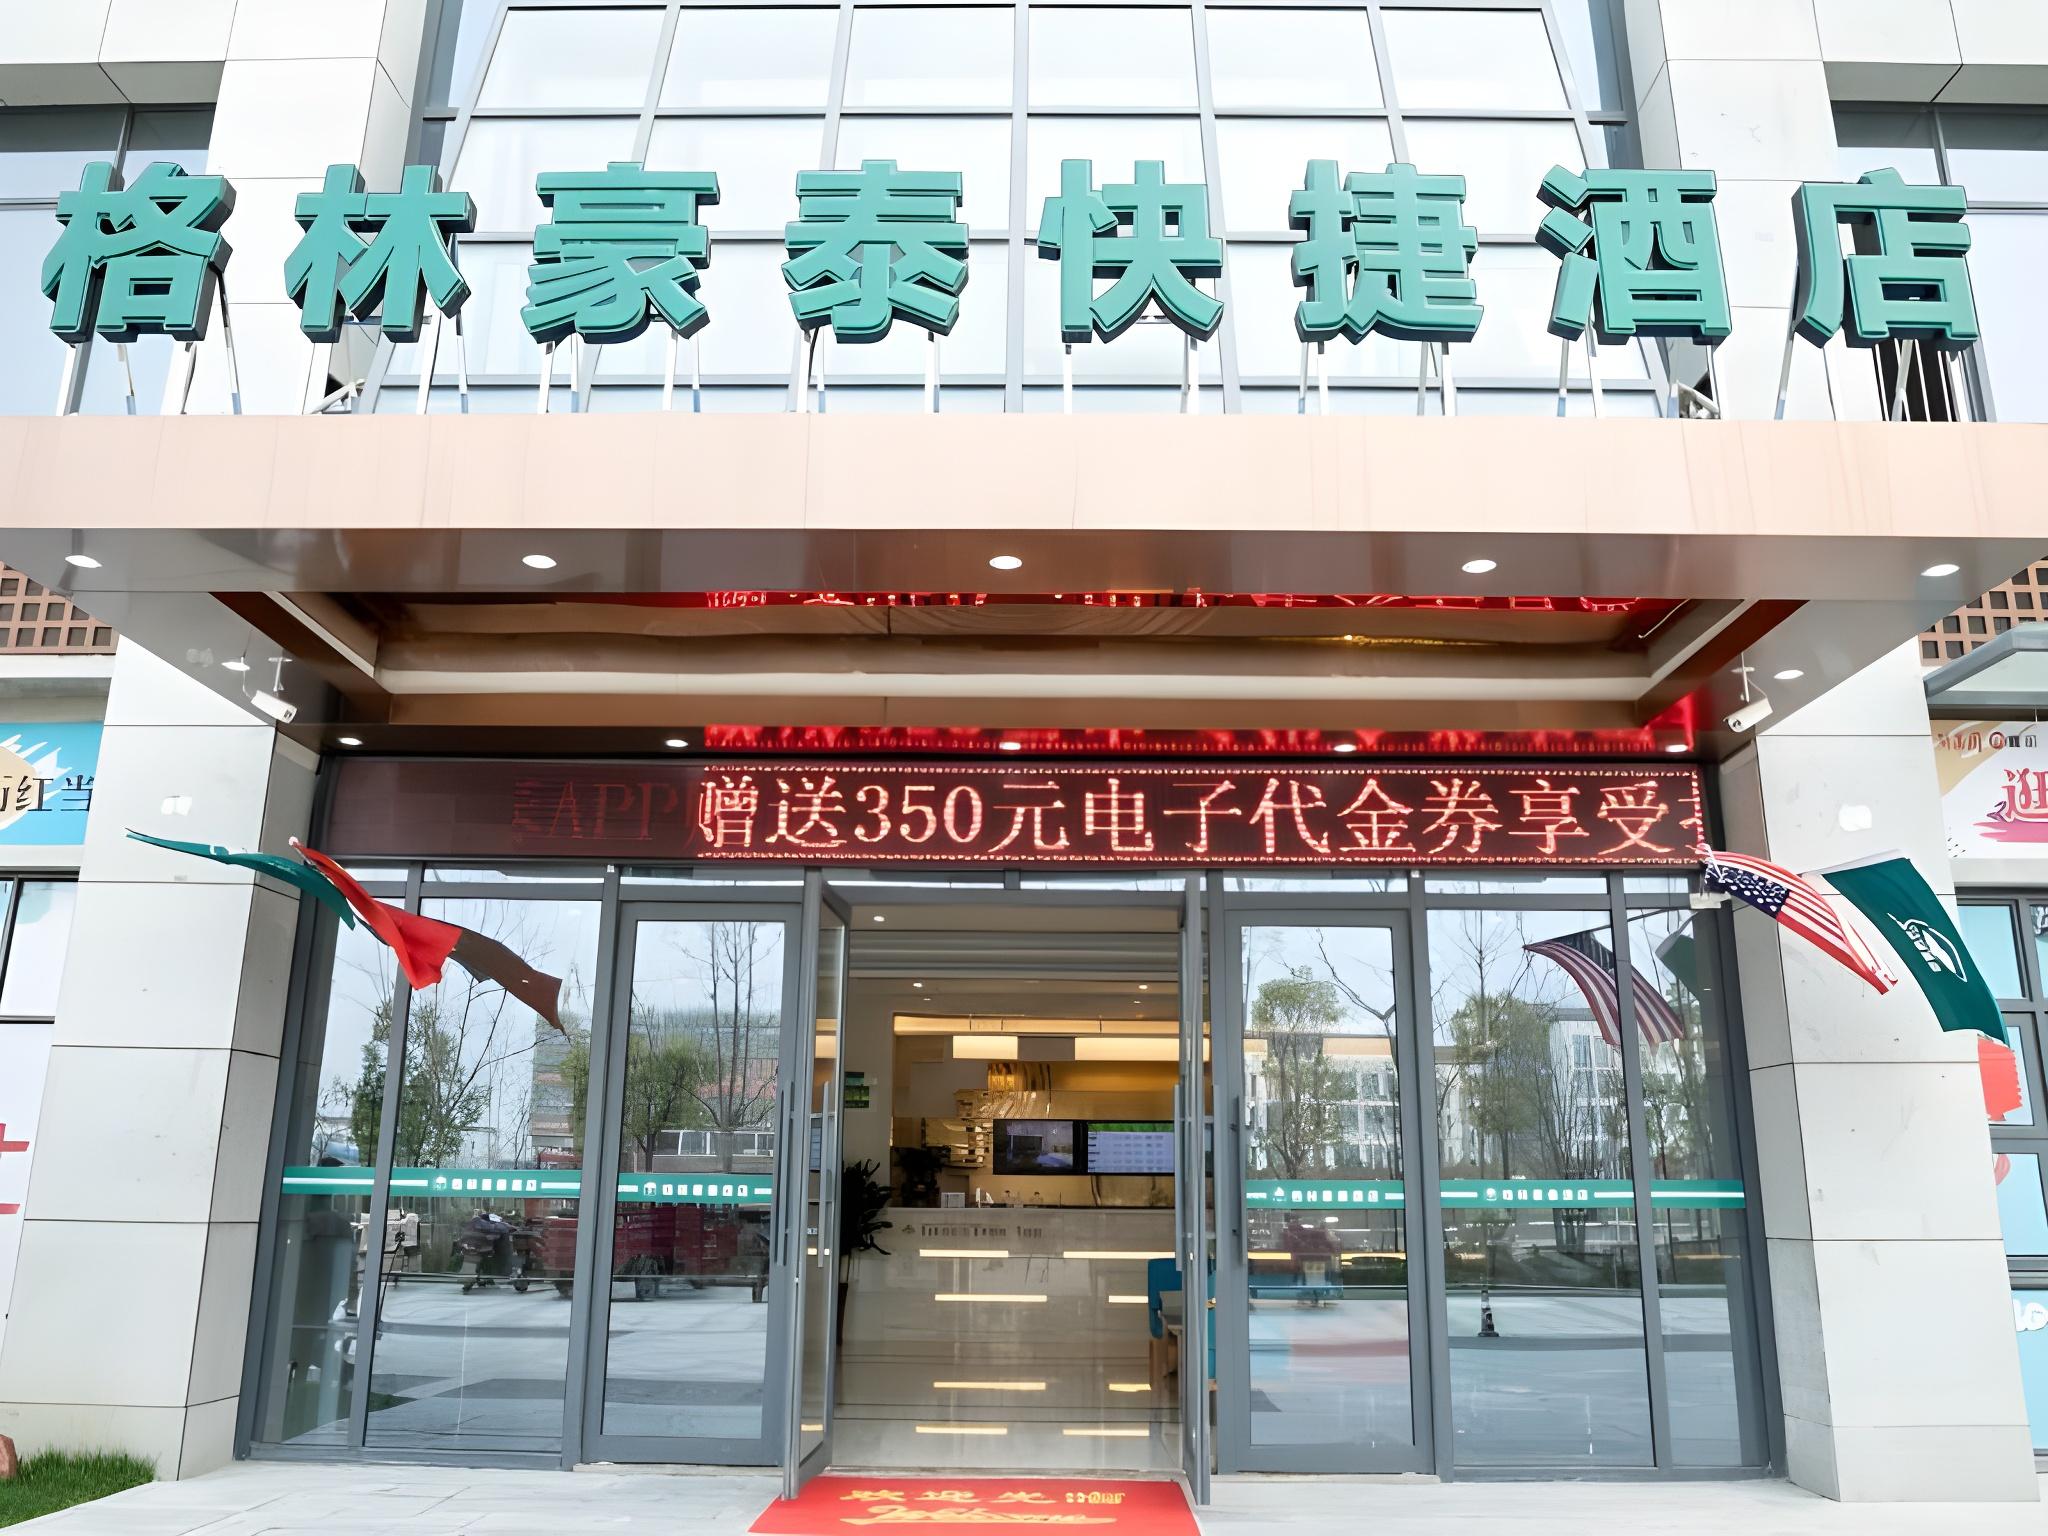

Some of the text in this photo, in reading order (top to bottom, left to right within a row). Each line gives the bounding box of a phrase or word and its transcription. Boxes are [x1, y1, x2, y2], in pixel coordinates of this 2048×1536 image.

[40, 160, 1981, 349] 格林豪泰快捷酒店
[697, 775, 1702, 855] 赠送350元电子代金券享受
